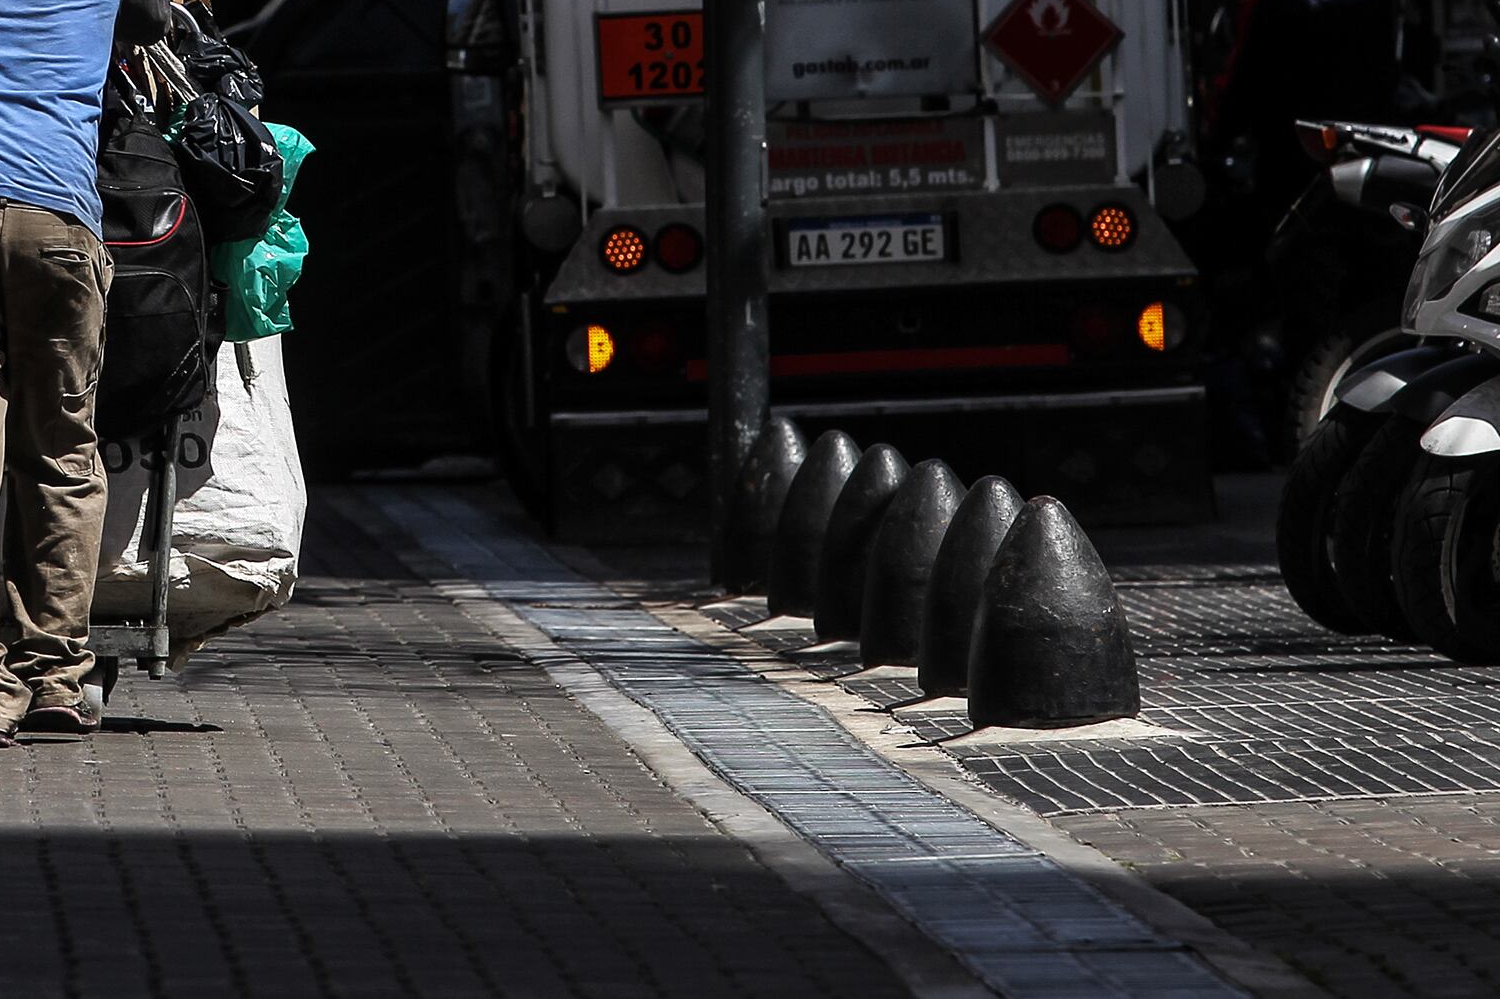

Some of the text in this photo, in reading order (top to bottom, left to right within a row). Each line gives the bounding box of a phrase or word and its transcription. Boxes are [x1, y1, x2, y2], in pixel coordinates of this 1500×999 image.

[643, 21, 691, 50] 30
[793, 55, 931, 79] gastab.com.ar
[825, 169, 883, 190] total:
[928, 167, 975, 185] mts.
[797, 228, 937, 260] AA 292 GE
